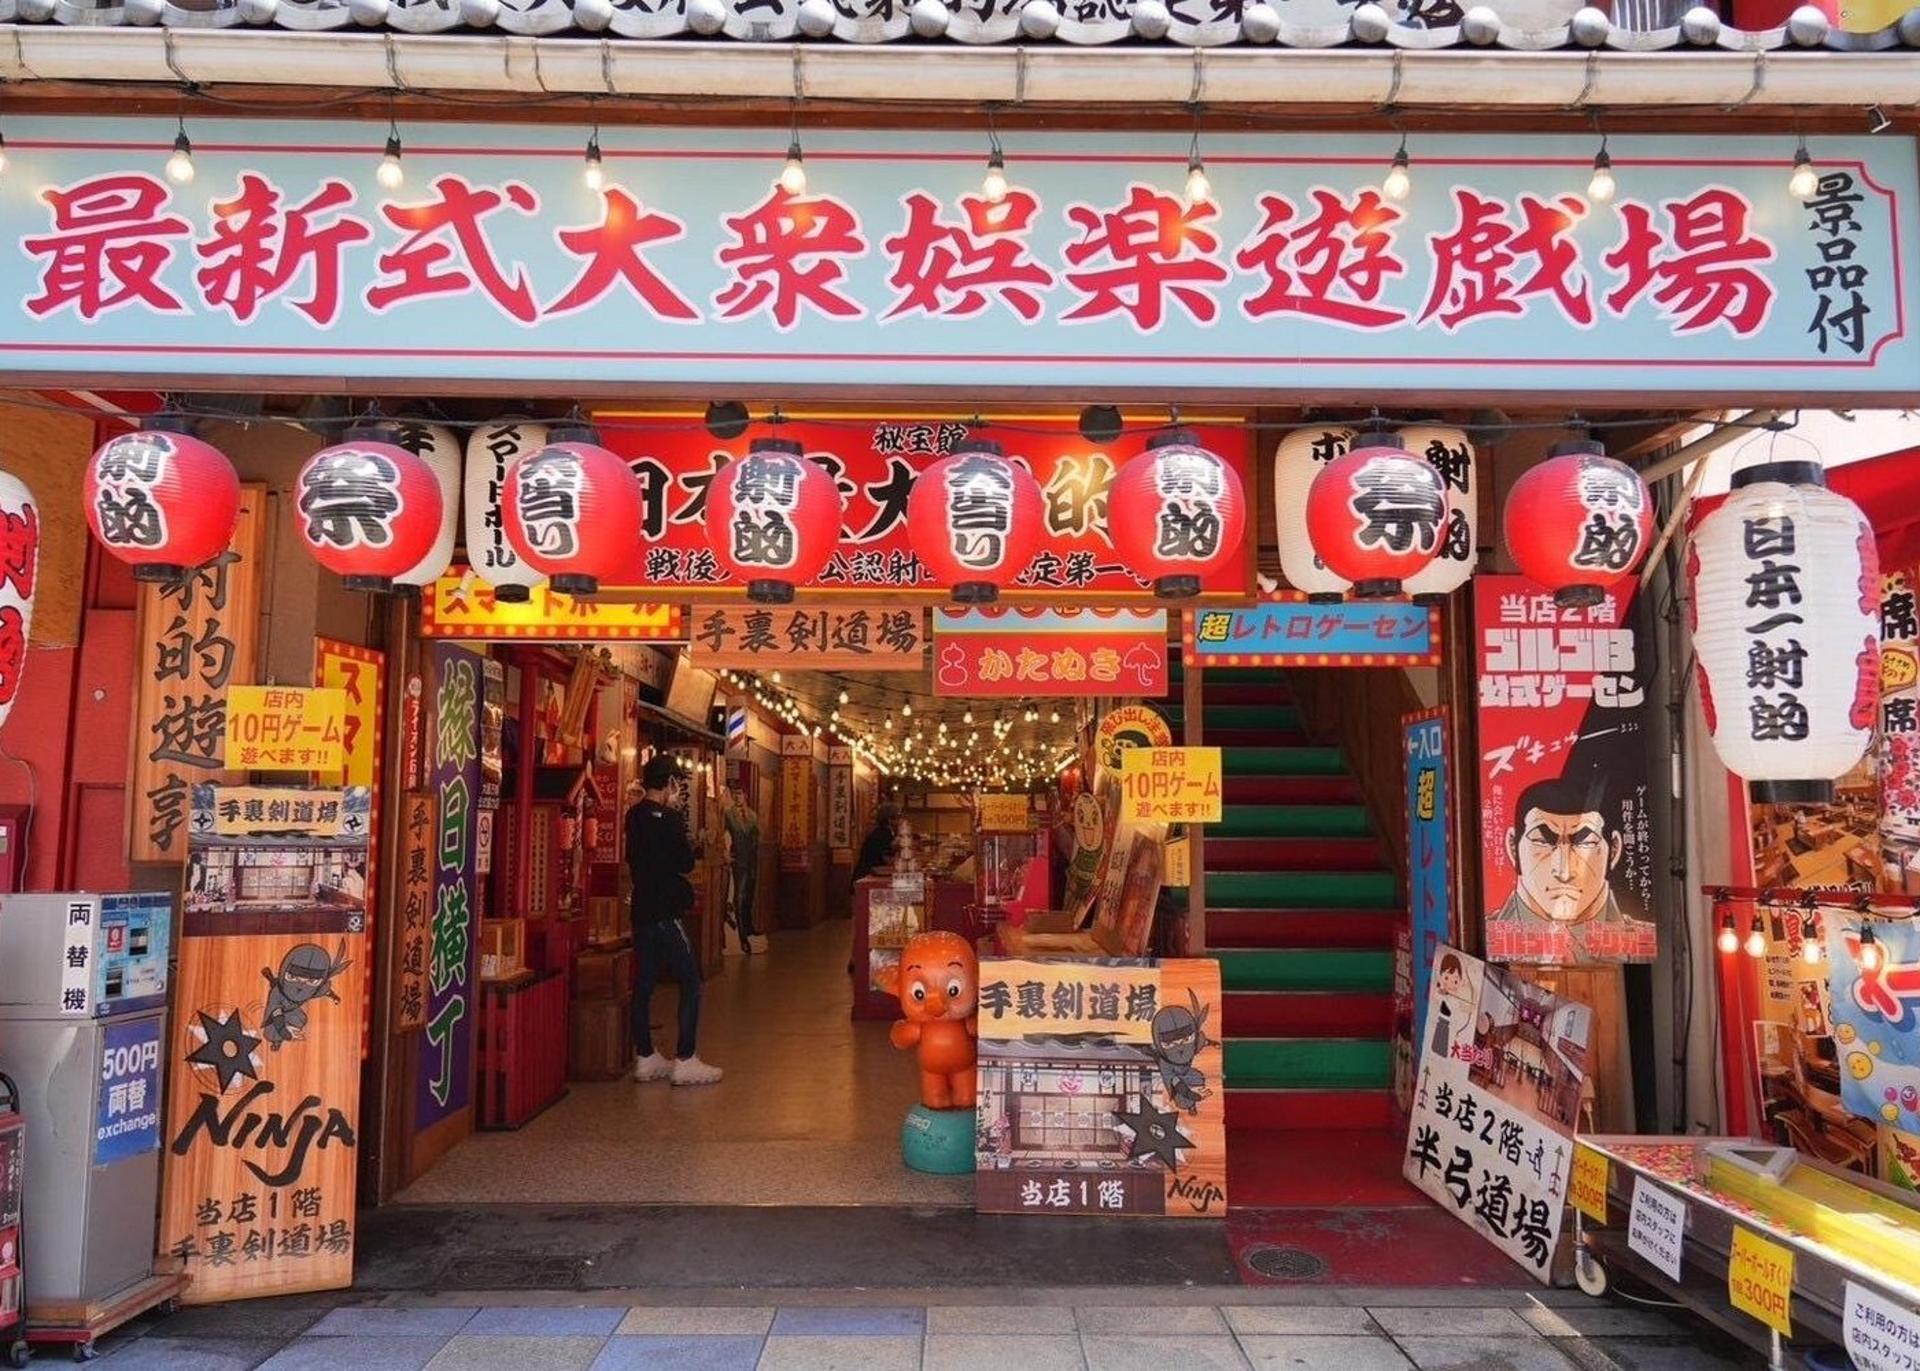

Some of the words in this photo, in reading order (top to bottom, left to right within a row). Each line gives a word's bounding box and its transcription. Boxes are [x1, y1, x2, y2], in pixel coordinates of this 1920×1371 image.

[23, 175, 1775, 334] 最新式大衆娯楽遊戯場
[1803, 171, 1871, 354] 景品付
[97, 434, 173, 545] 射的
[302, 451, 400, 547] 祭
[519, 447, 582, 556] 大当り
[733, 456, 801, 565] 射的
[950, 454, 1011, 565] 大当り
[1158, 450, 1221, 556] 射的
[1352, 459, 1445, 551] 祭
[1574, 453, 1643, 569] 射的
[695, 610, 917, 655] 手裏剣道場
[1198, 611, 1426, 643] 超レトロゲーセン
[1743, 515, 1810, 742] 日本一射的
[978, 647, 1121, 682] かたぬき
[263, 690, 305, 708] 店内
[229, 713, 341, 745] 10円ゲーム
[240, 746, 329, 766] 遊べます!!
[1151, 750, 1186, 767] 店内
[1124, 770, 1220, 799] 10円ゲーム
[218, 799, 339, 824] 手裏剣道場
[1135, 801, 1212, 819] 遊べます!!
[427, 658, 478, 1107] 縁日横丁
[400, 801, 430, 1022] 手裏剣道場
[63, 903, 92, 1012] 両替機
[979, 979, 1158, 1022] 手裏剣道場
[102, 1040, 159, 1081] 500円
[108, 1078, 147, 1118] 両替
[97, 1112, 156, 1141] exchange
[1434, 1081, 1525, 1166] 当店2階
[195, 1187, 323, 1227] 当店1階
[1020, 1179, 1125, 1210] 当店1階
[1410, 1123, 1552, 1269] 半弓道場
[171, 1219, 352, 1267] 手裏剣道場
